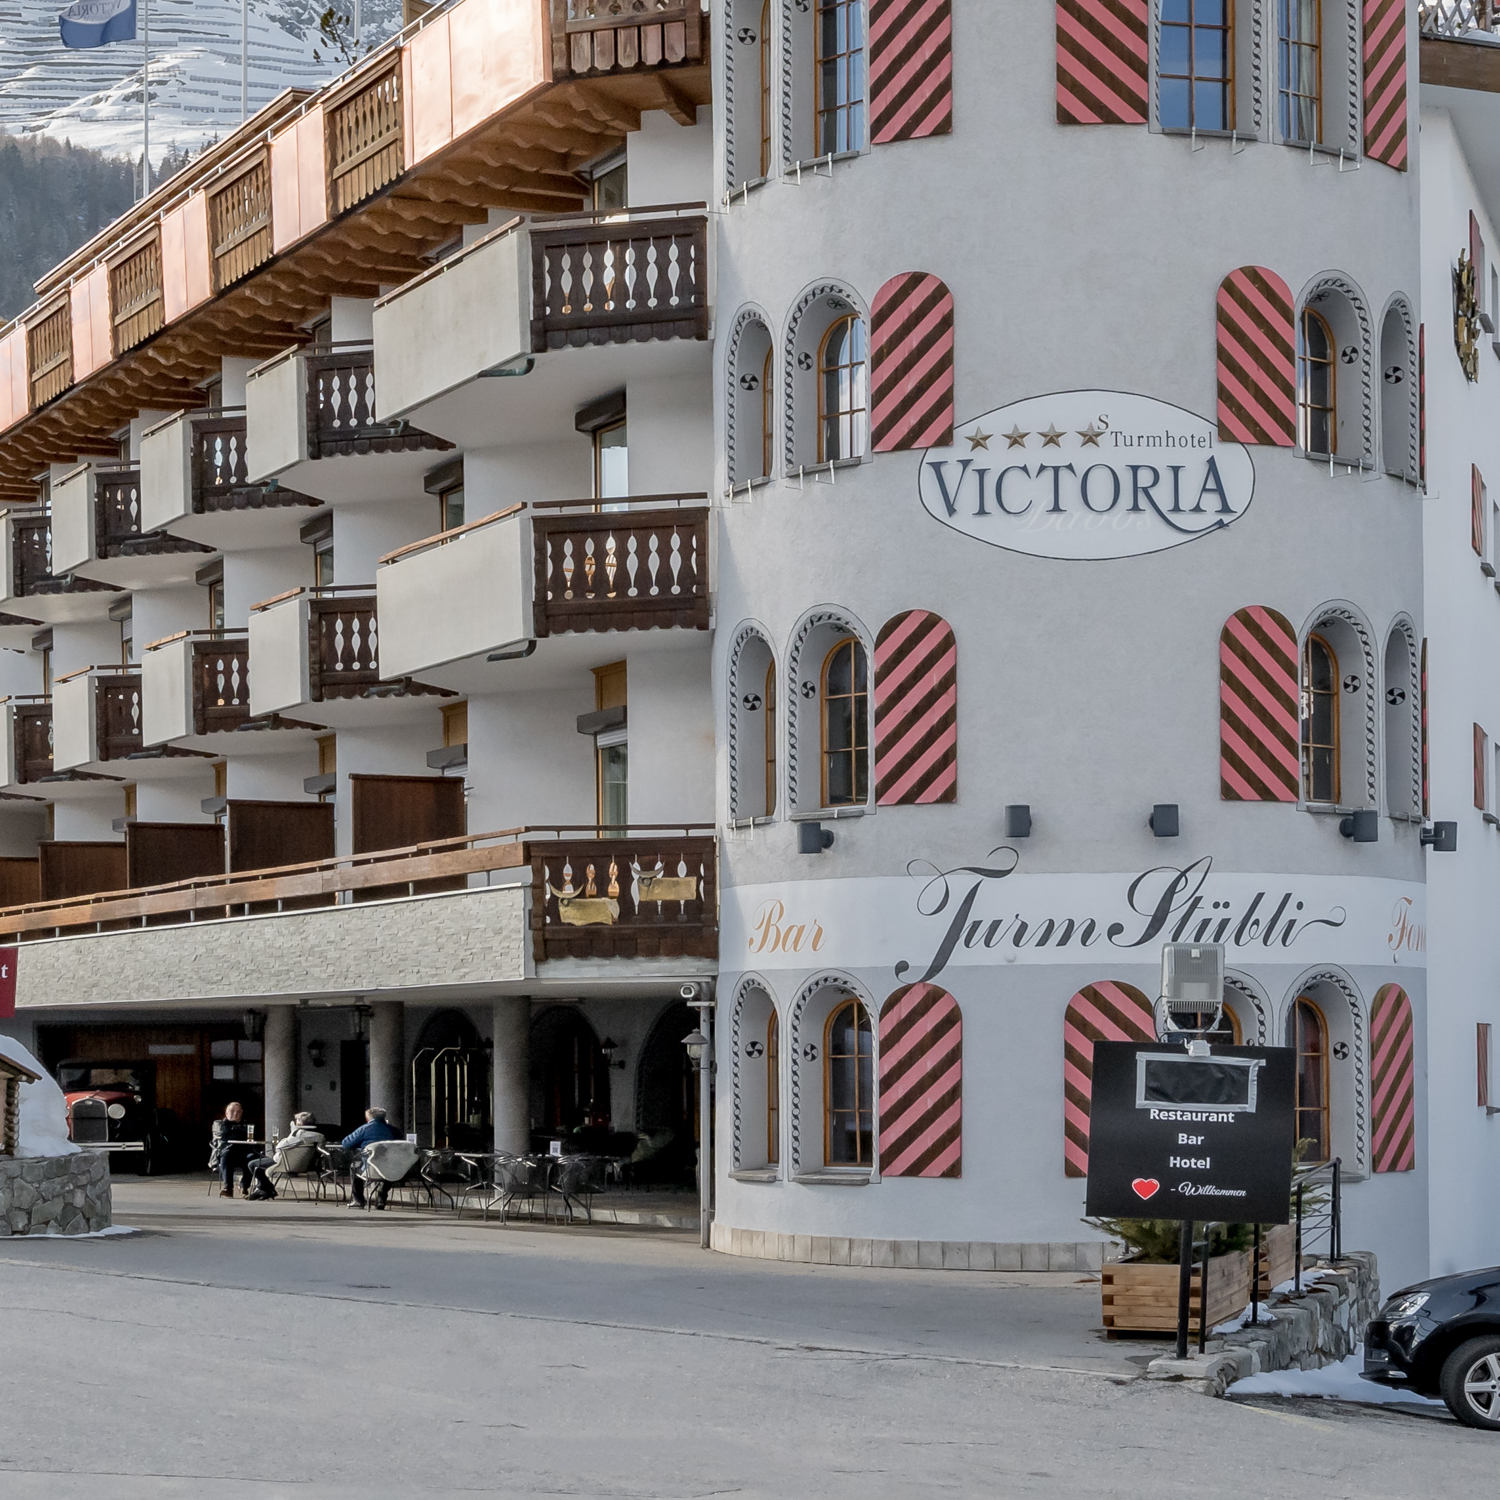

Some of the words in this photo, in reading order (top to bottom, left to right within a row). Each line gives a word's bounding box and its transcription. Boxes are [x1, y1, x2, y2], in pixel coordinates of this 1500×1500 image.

[1110, 430, 1214, 449] Turmhotel
[926, 455, 1238, 533] VICTORIA
[748, 898, 827, 954] Bar
[1150, 1108, 1235, 1123] Restaurant
[1178, 1133, 1205, 1145] Bar
[1169, 1156, 1211, 1169] Hotel
[1178, 1181, 1247, 1197] Willkommen
